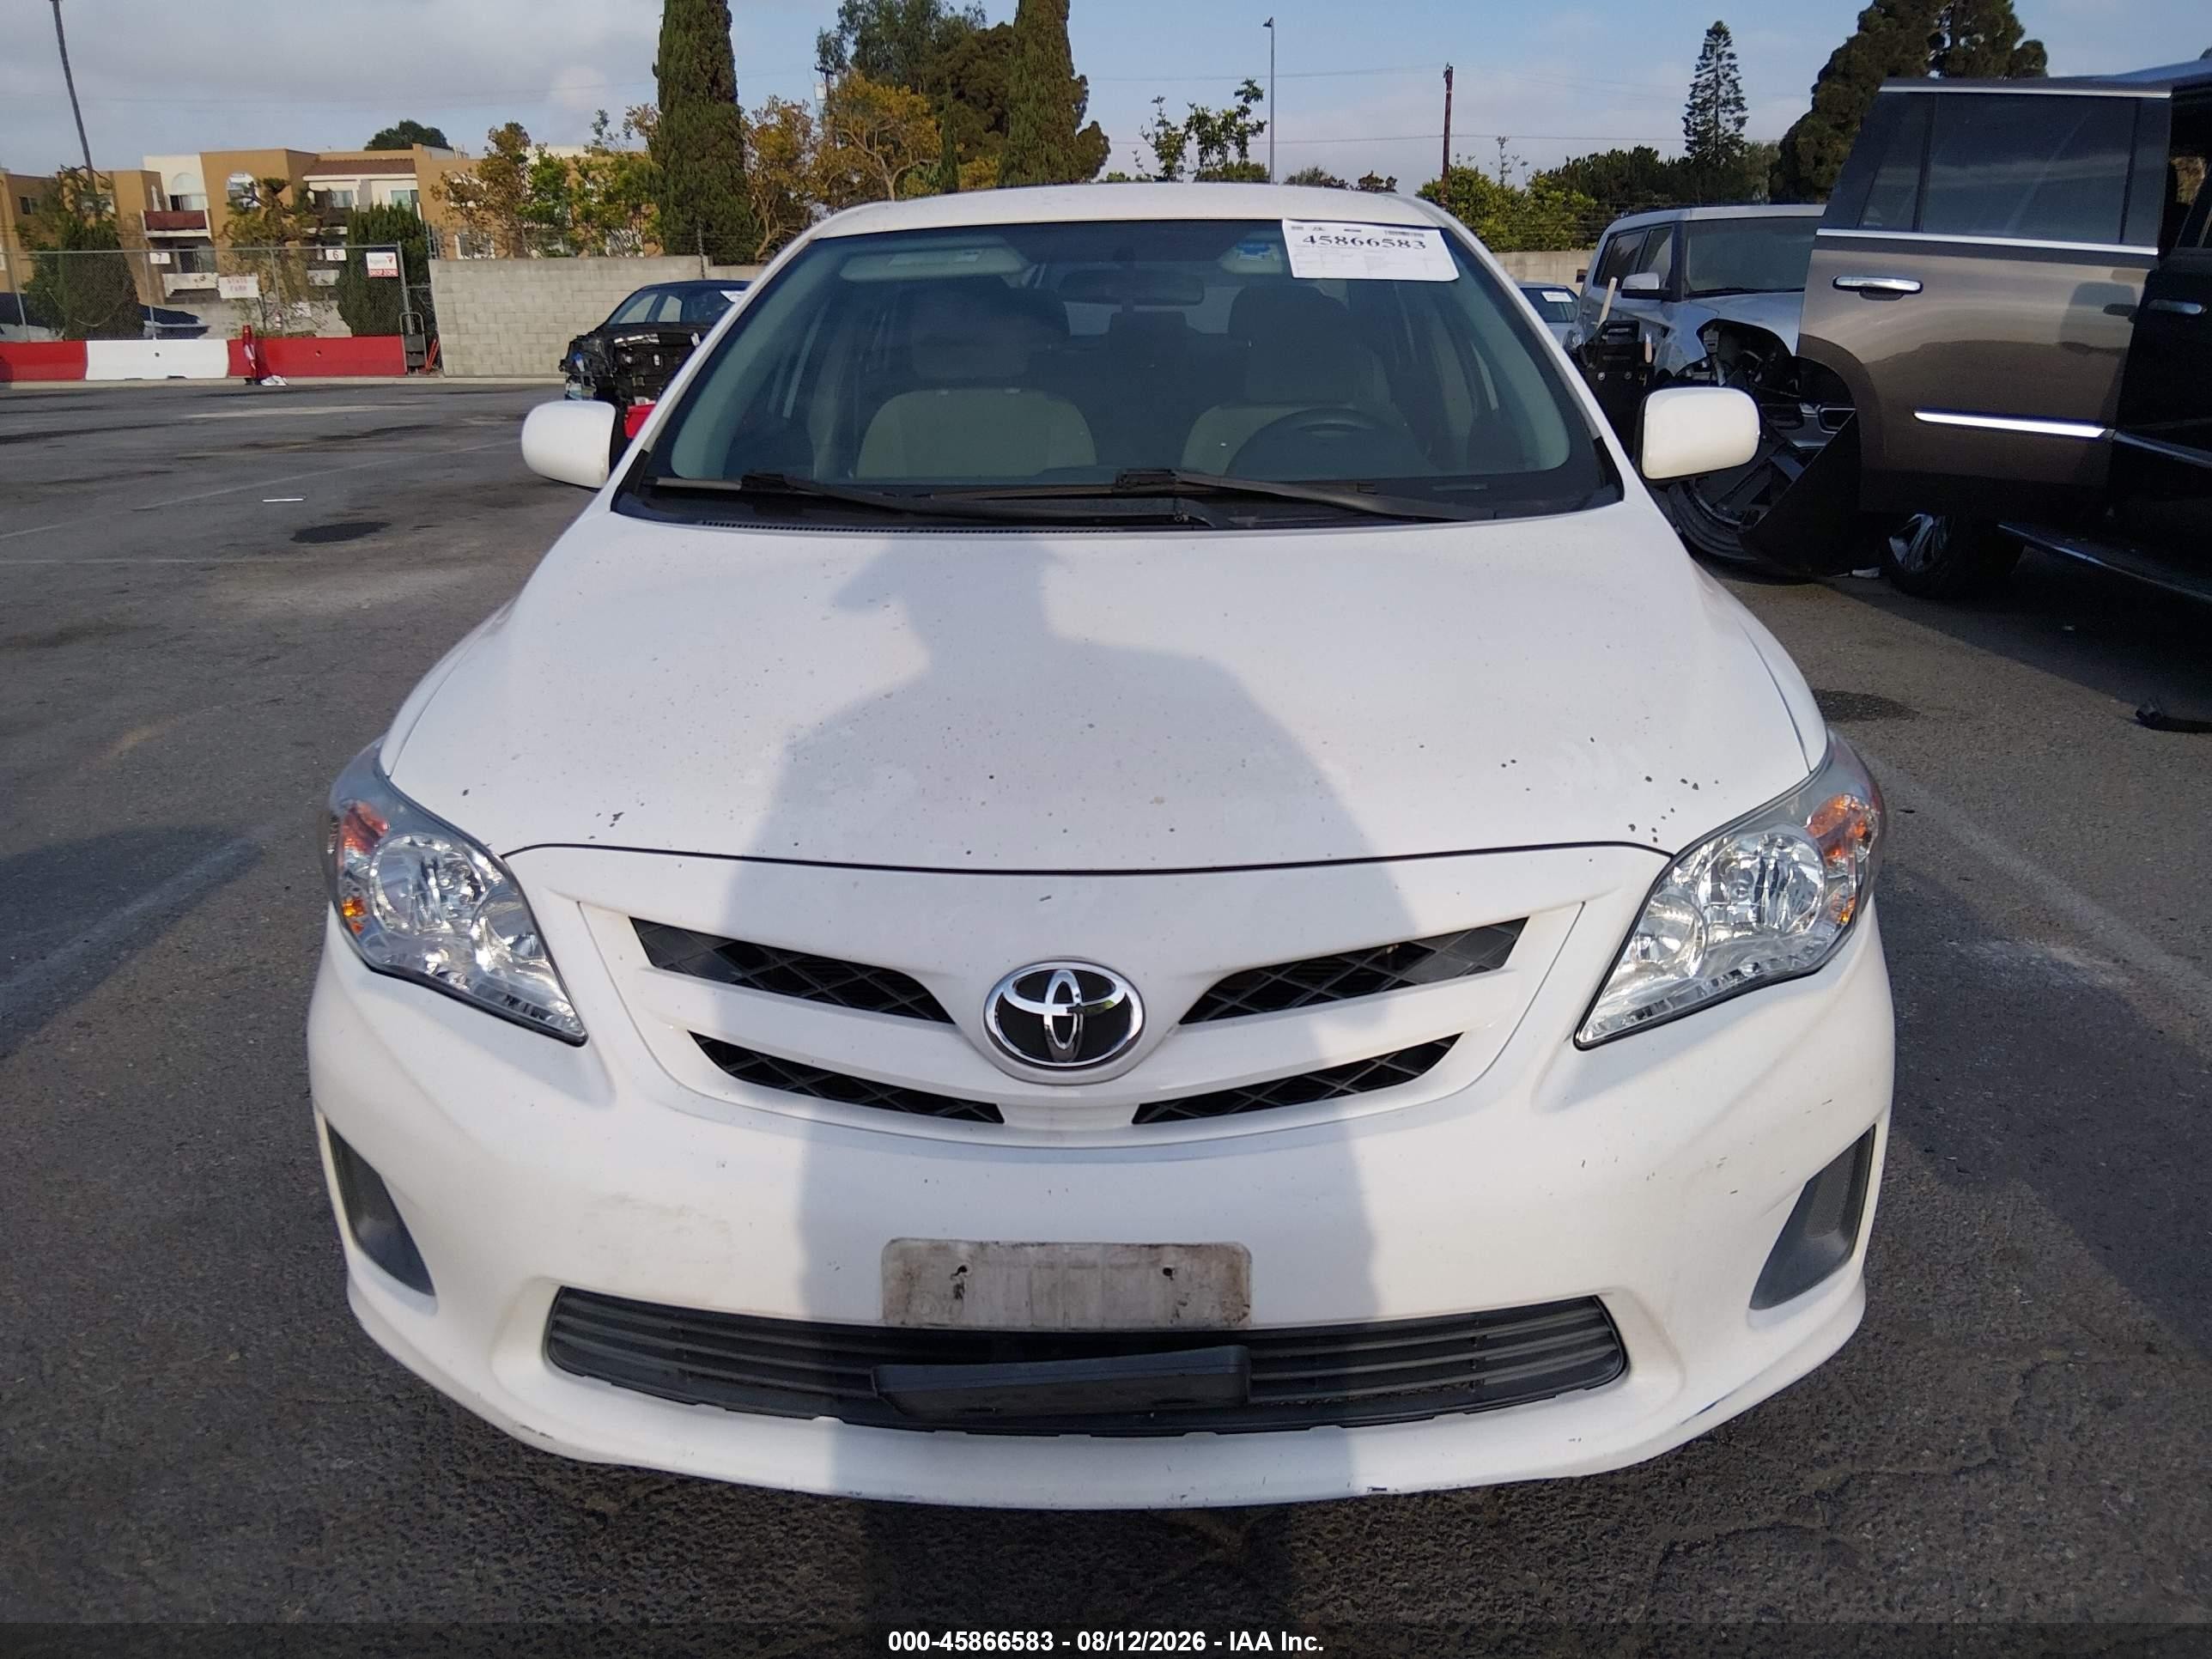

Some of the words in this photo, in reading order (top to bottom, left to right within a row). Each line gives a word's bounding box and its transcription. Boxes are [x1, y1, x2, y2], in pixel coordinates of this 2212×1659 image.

[1303, 234, 1426, 249] 45866583
[155, 252, 162, 262] 7
[332, 249, 339, 259] 6
